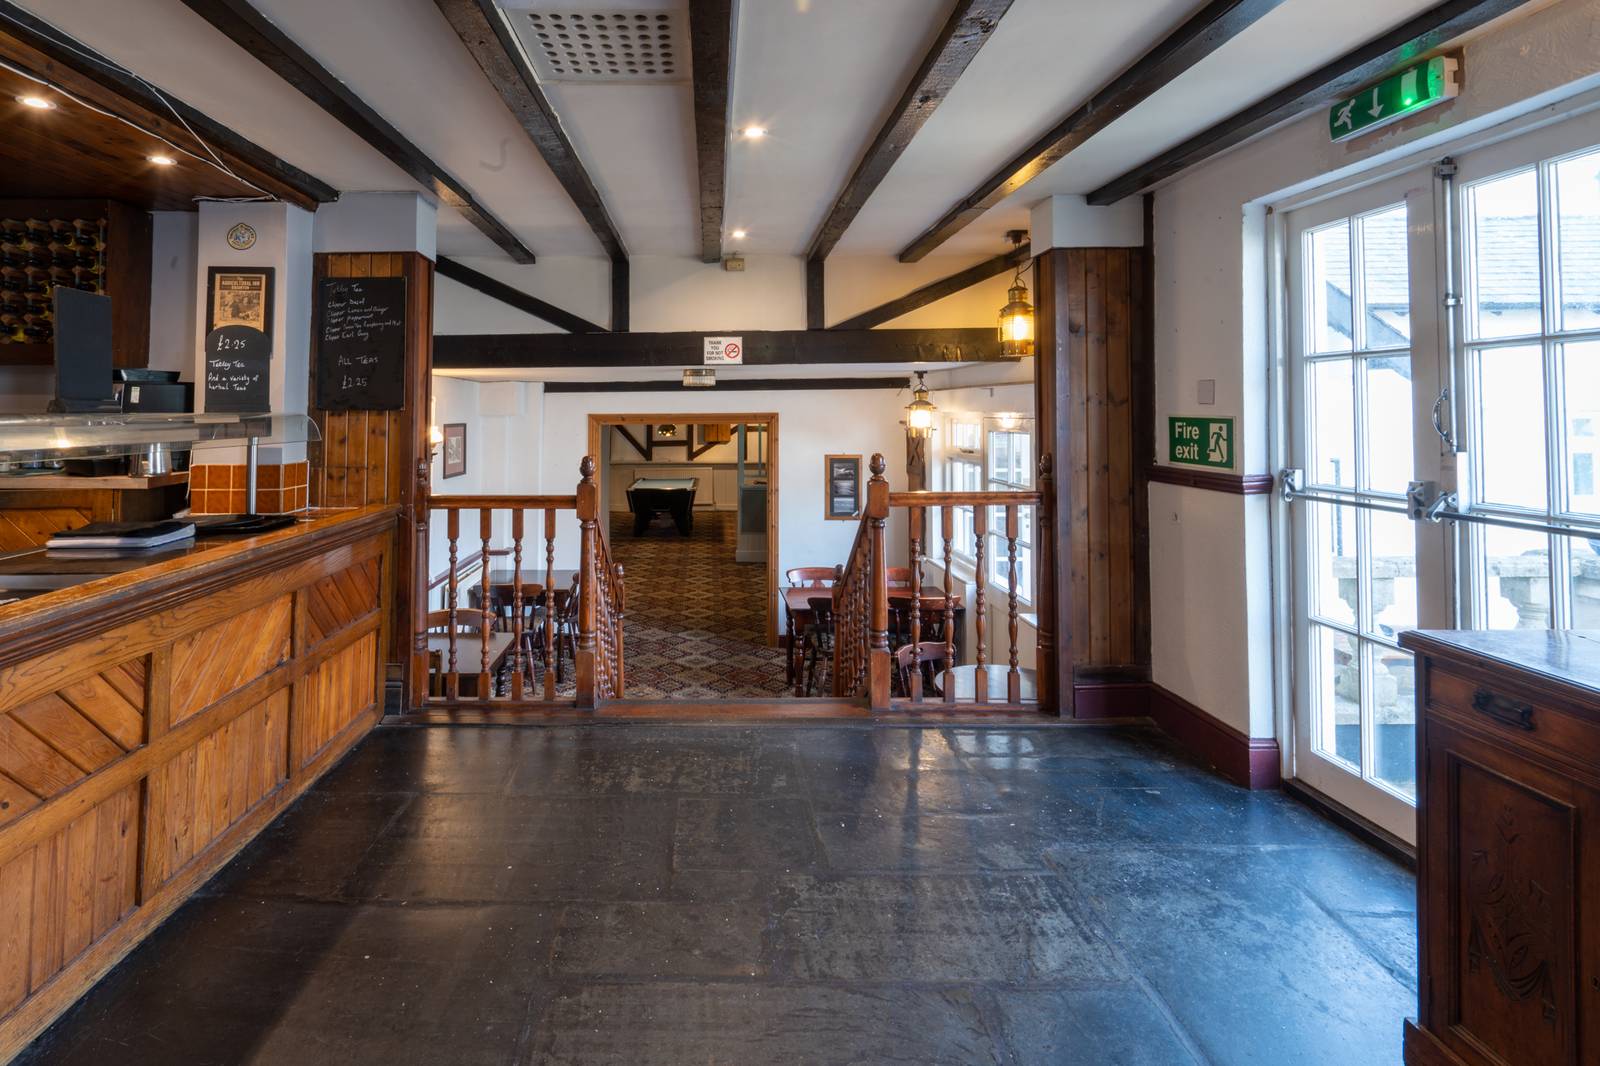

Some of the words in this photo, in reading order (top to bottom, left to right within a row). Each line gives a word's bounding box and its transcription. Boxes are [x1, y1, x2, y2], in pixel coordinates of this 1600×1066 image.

[217, 334, 248, 351] £2.25
[232, 360, 246, 368] Tea
[1175, 422, 1200, 440] Fire
[1175, 442, 1199, 460] exit
